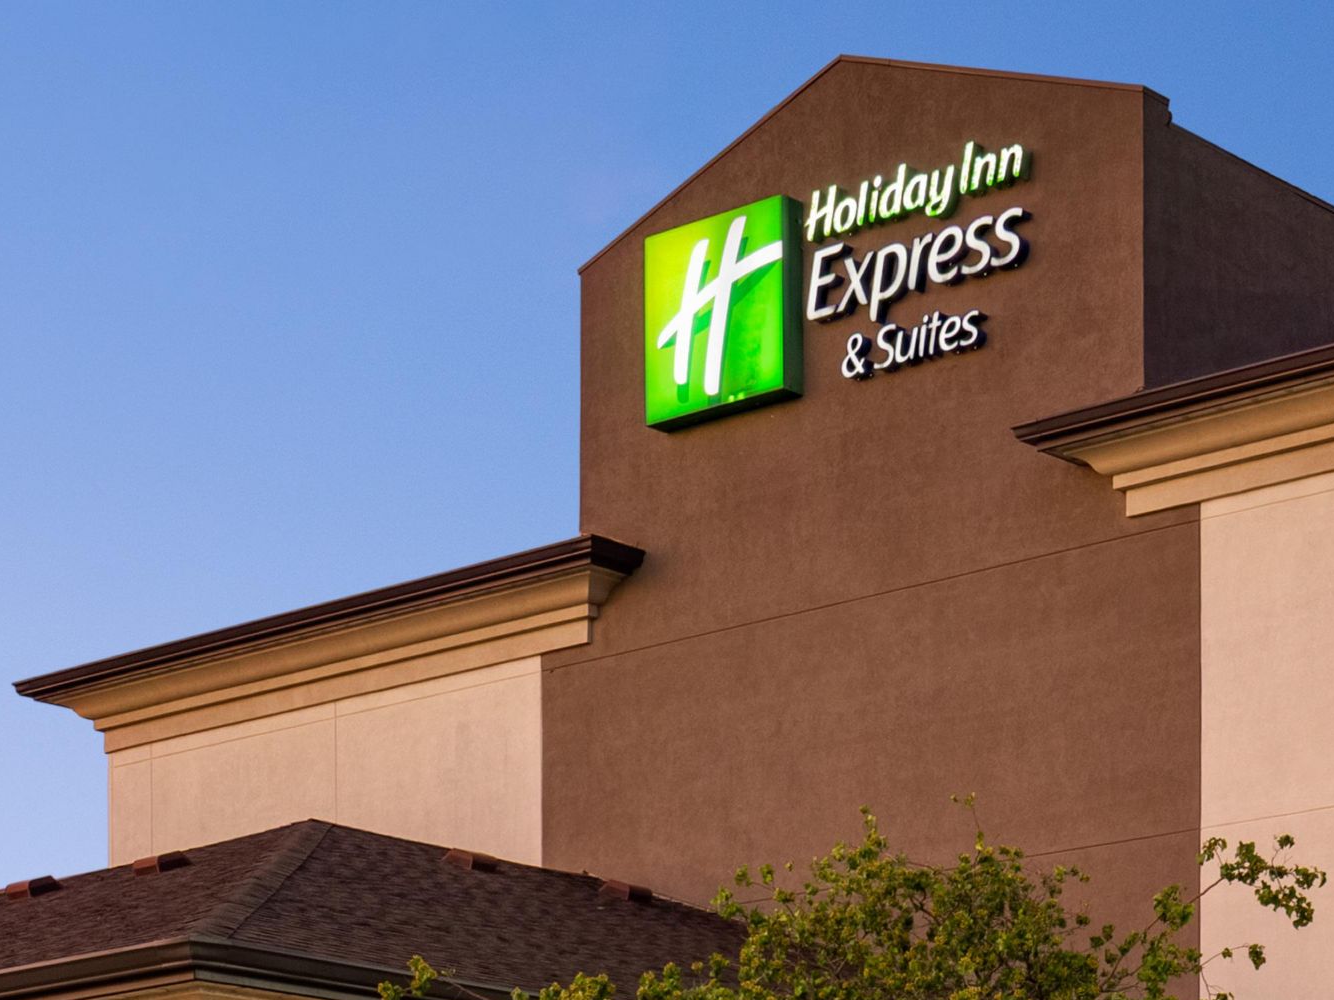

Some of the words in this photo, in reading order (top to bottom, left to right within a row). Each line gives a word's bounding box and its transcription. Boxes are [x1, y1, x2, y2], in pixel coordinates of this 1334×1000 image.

[805, 163, 954, 241] Holiday
[960, 141, 1023, 194] Inn
[657, 216, 782, 395] H
[807, 207, 1023, 322] Express
[841, 332, 865, 378] &
[874, 310, 979, 369] Suites
